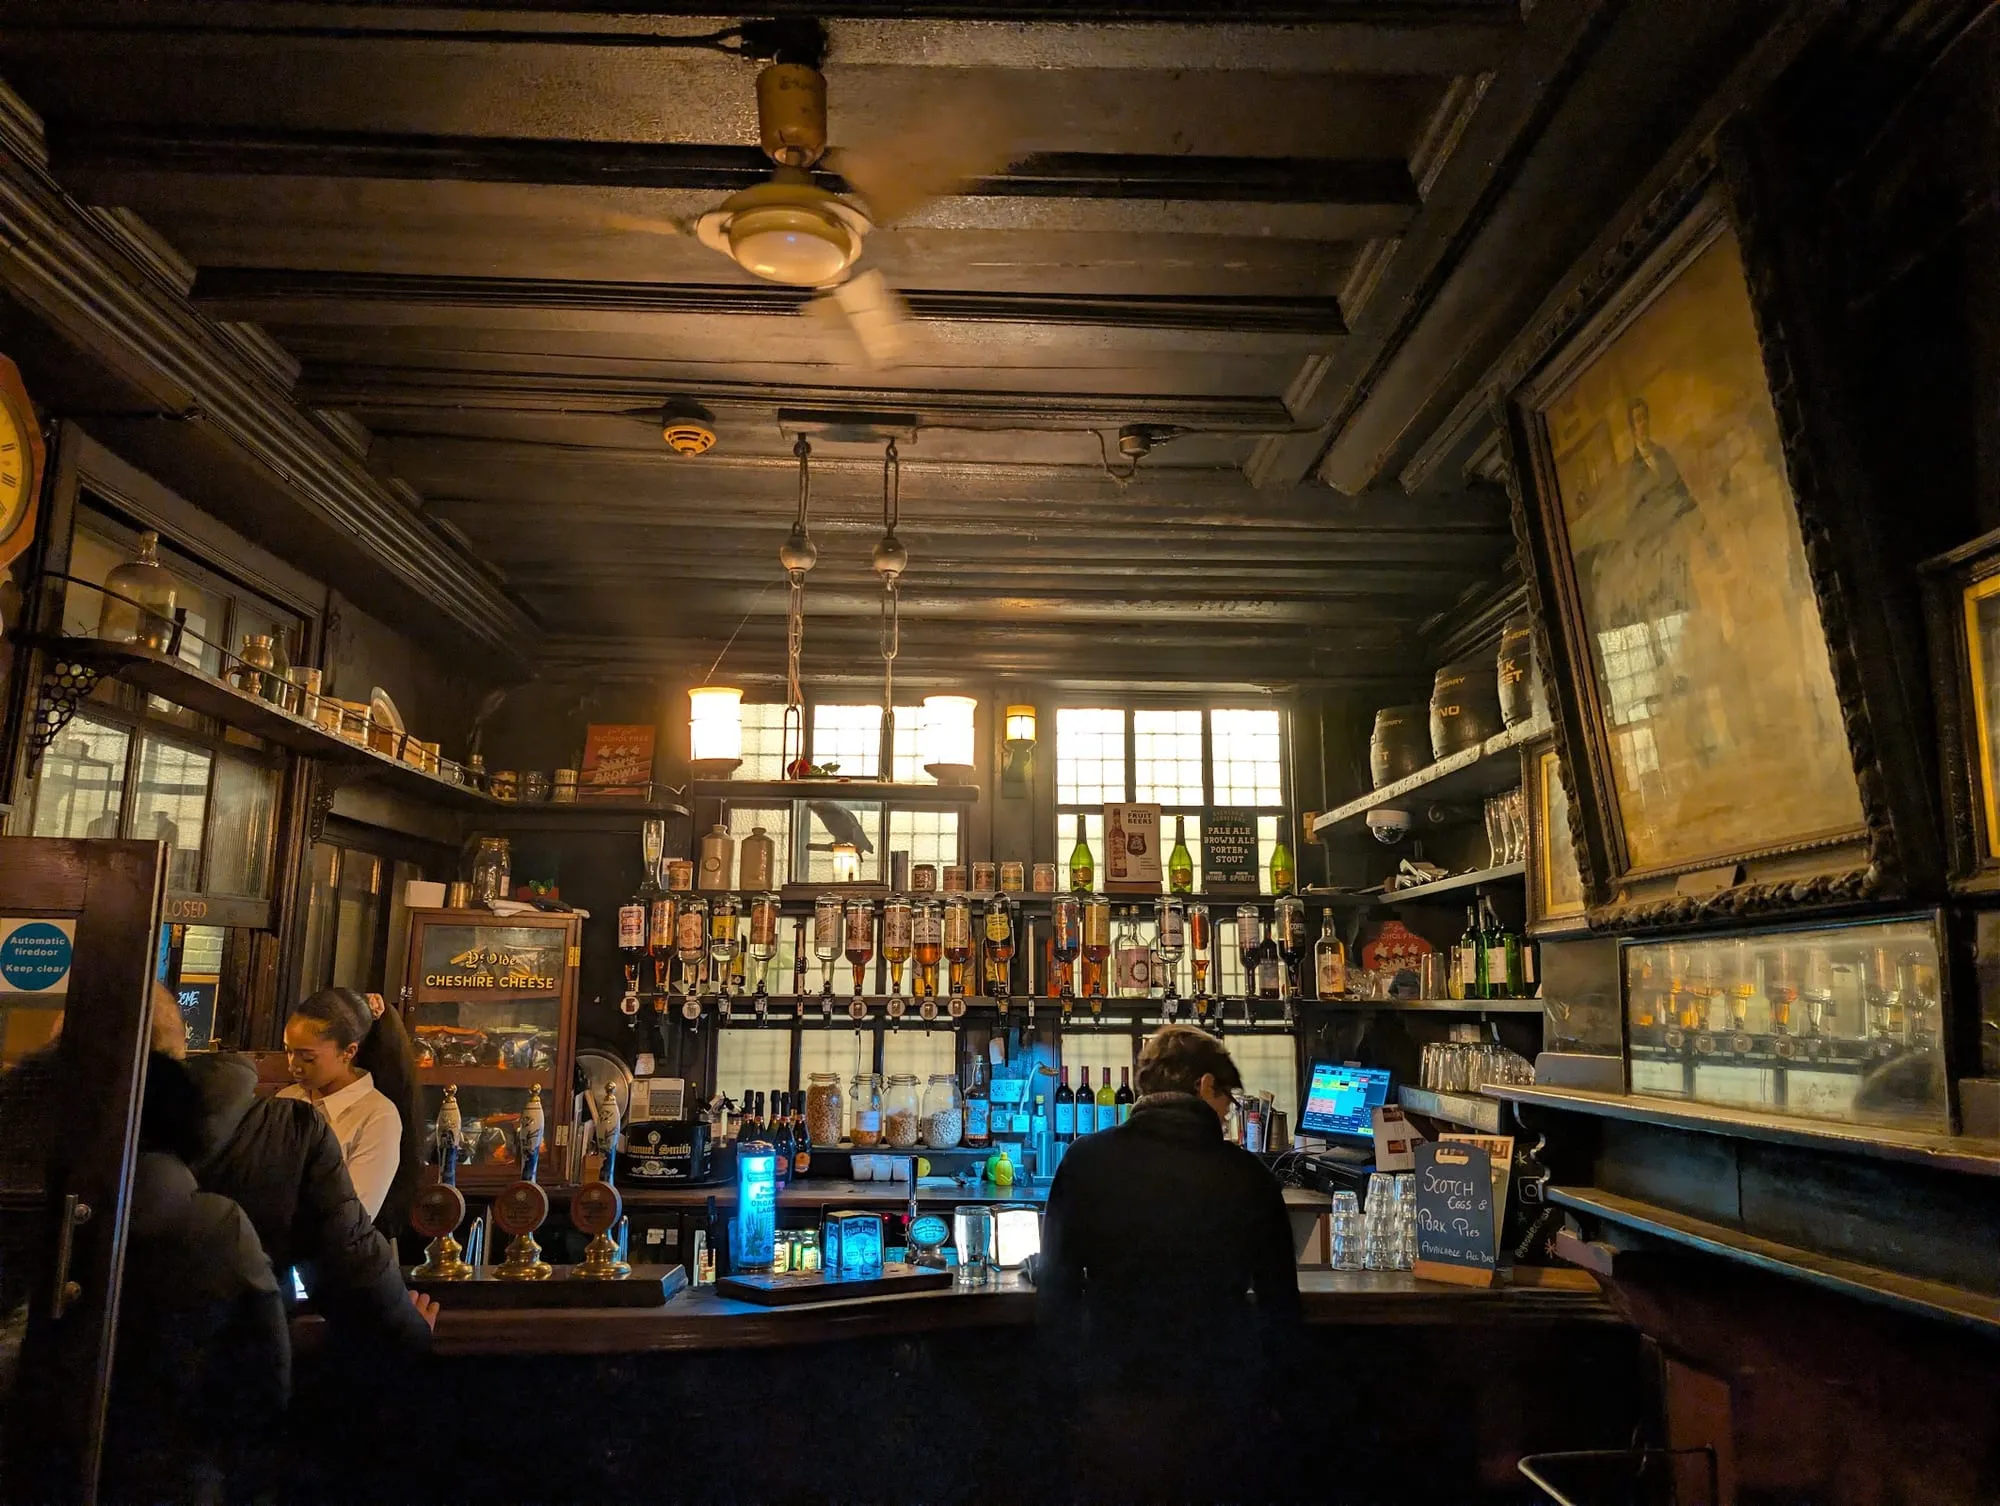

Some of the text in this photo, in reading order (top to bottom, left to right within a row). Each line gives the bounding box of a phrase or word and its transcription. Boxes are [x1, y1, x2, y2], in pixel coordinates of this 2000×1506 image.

[1204, 836, 1256, 844] BROWN ALE
[1210, 846, 1243, 854] PORTER
[1215, 855, 1244, 863] STOUT
[165, 900, 208, 918] LOSED
[10, 937, 65, 945] Automatic
[15, 948, 58, 956] firedoor
[487, 953, 517, 966] Olde
[6, 964, 64, 974] Keep clear
[426, 975, 554, 989] CHESHIRE CHEESE
